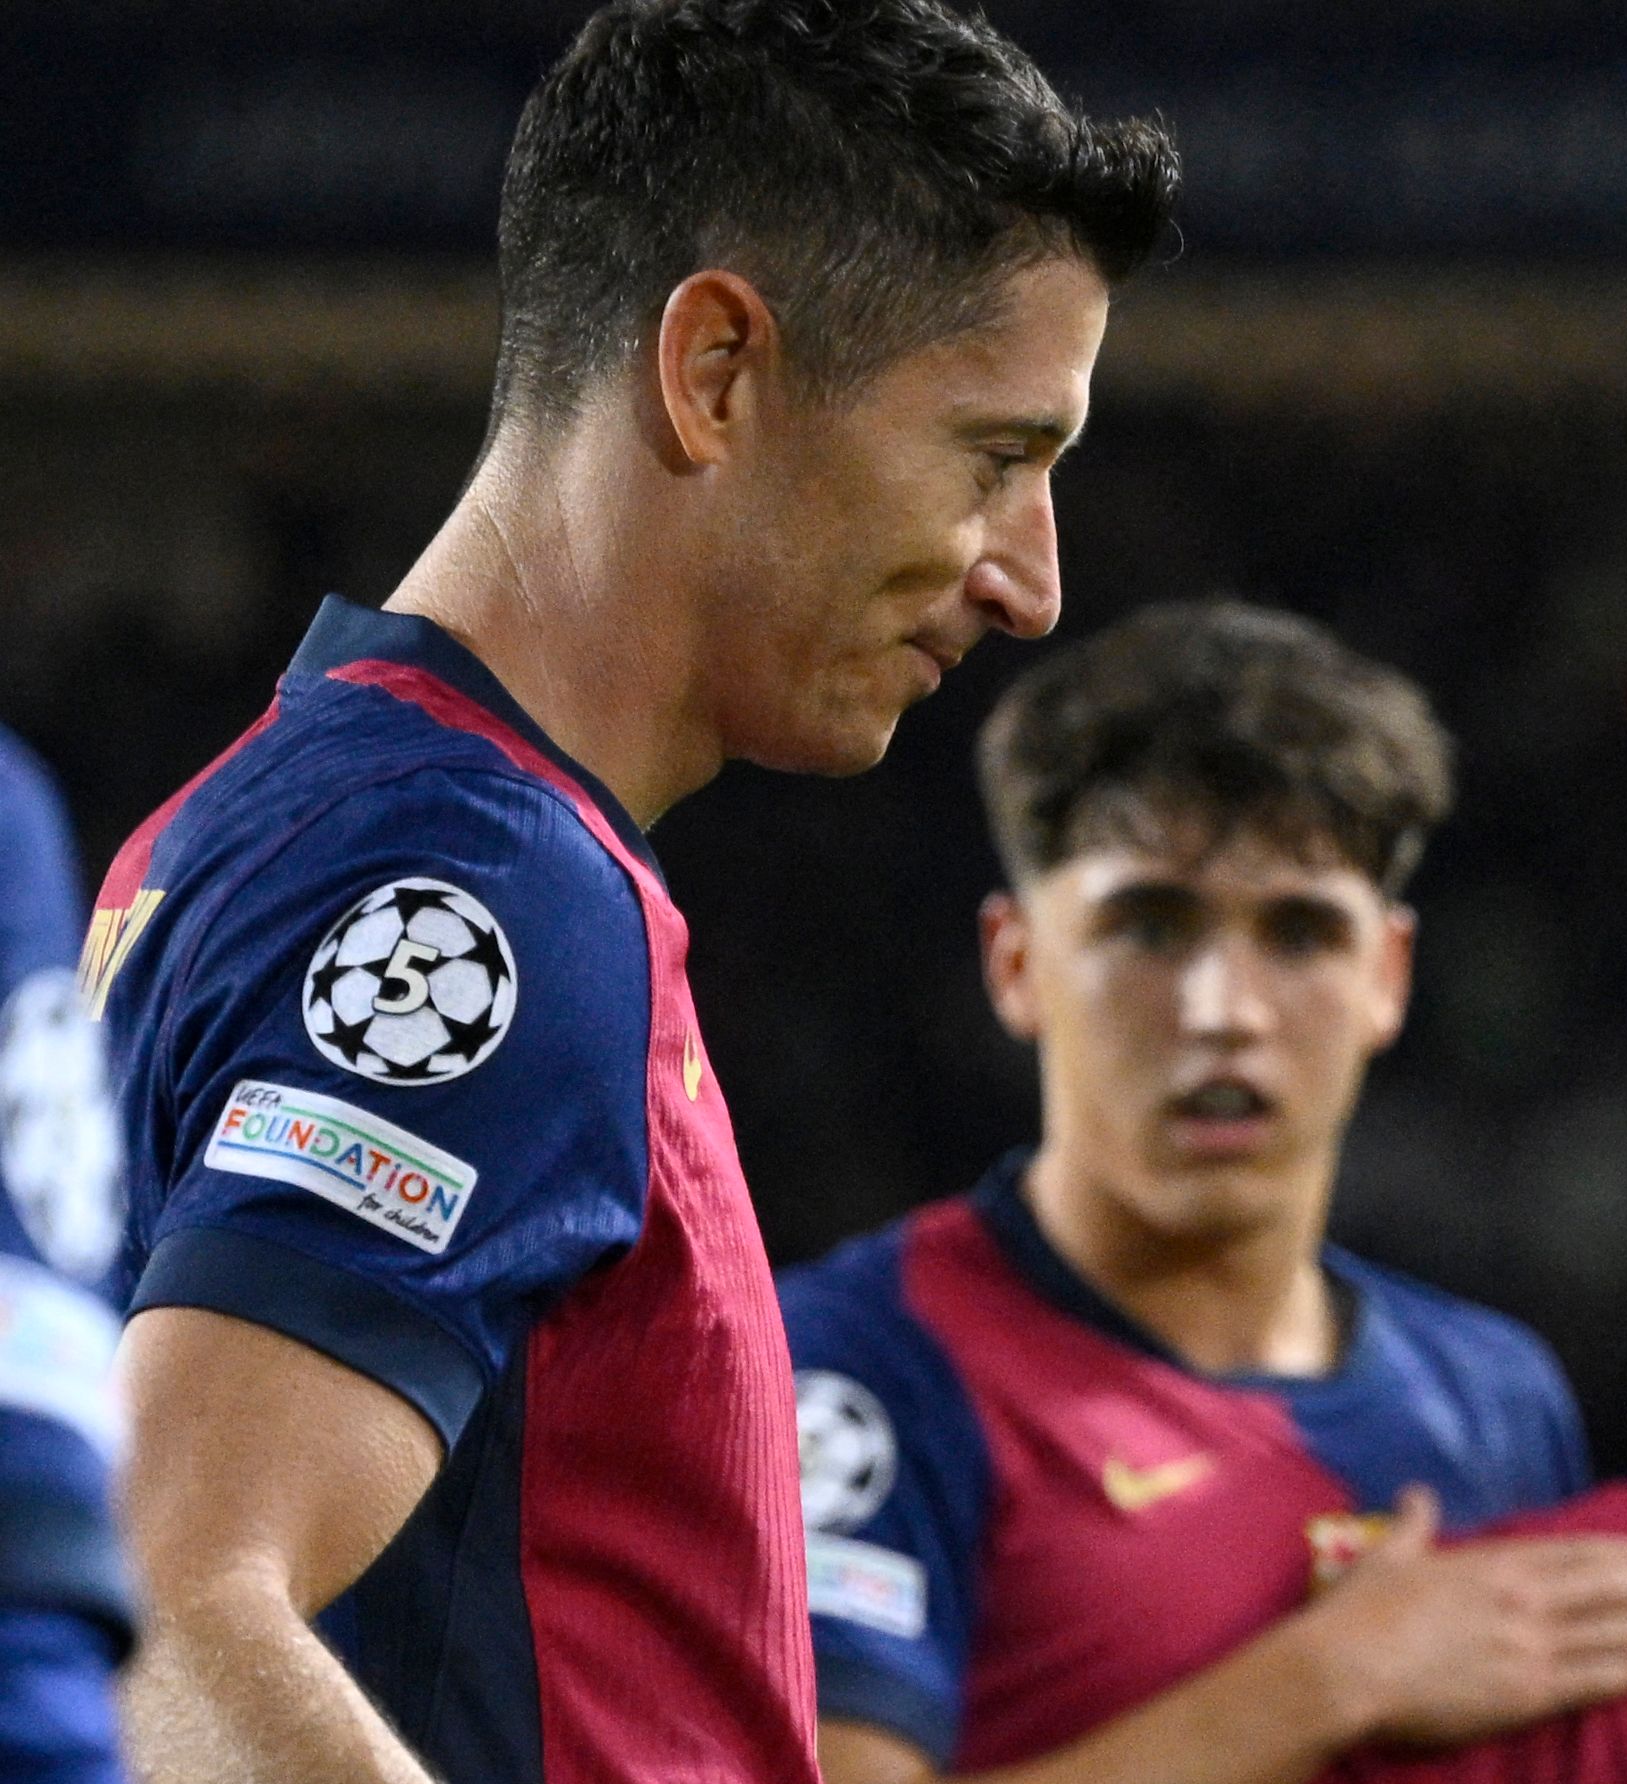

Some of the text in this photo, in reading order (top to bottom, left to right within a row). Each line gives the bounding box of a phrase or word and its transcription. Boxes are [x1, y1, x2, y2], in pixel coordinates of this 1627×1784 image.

[371, 937, 441, 1015] 5
[233, 1084, 283, 1108] UEFA
[220, 1107, 460, 1223] FOUNDATION
[356, 1191, 441, 1245] for children
